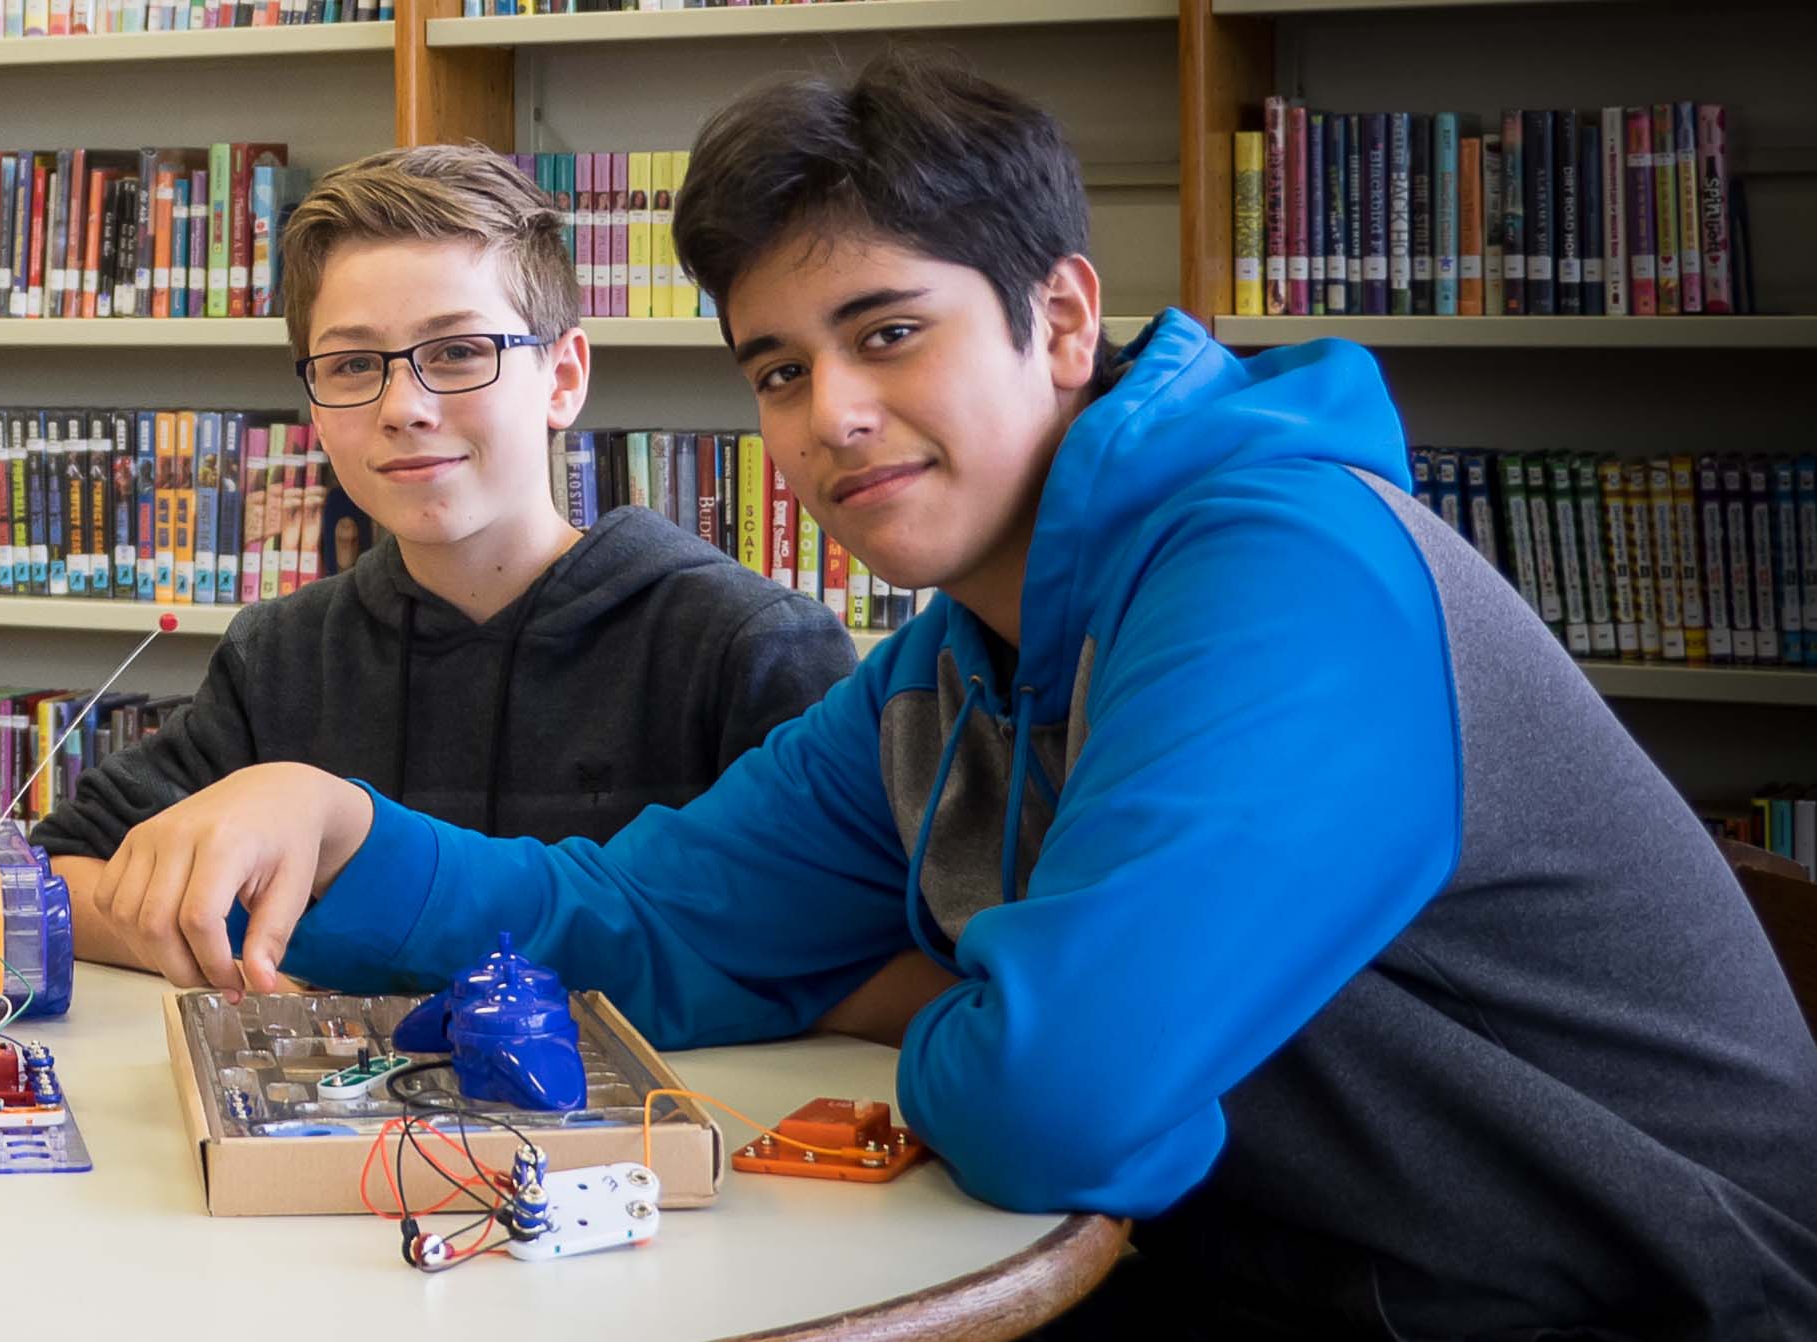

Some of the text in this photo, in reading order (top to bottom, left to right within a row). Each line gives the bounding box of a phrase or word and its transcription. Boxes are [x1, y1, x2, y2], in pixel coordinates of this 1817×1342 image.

[1370, 149, 1384, 235] Blackbird
[1390, 172, 1408, 219] BACK
[1564, 233, 1574, 259] HOM
[568, 463, 583, 526] FROSTED
[743, 504, 756, 563] SCAT
[801, 507, 813, 569] OOT
